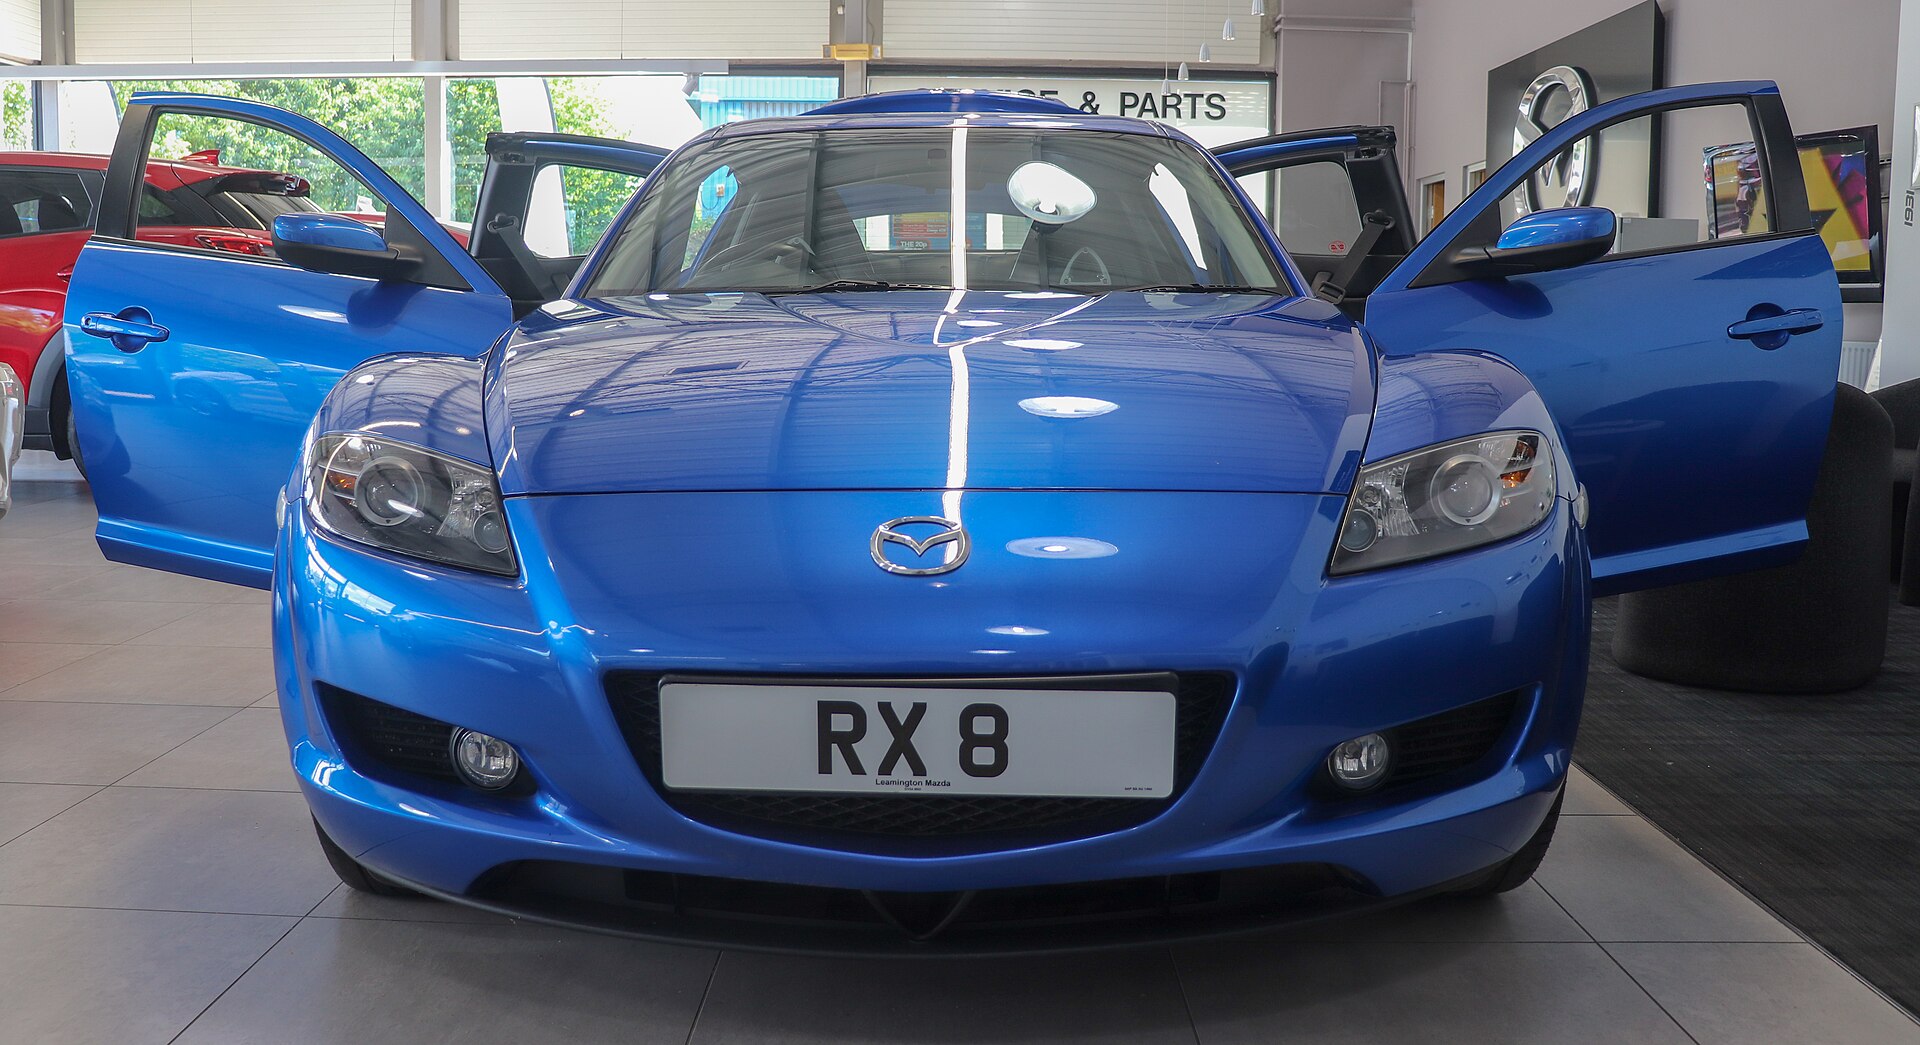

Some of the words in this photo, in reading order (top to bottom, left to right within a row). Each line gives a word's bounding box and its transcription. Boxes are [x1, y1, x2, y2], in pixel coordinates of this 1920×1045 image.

[1079, 91, 1100, 115] &
[1120, 92, 1227, 121] PARTS
[816, 700, 928, 776] RX
[958, 702, 1009, 778] 8
[875, 779, 923, 787] Leamington
[925, 779, 951, 787] Mazda
